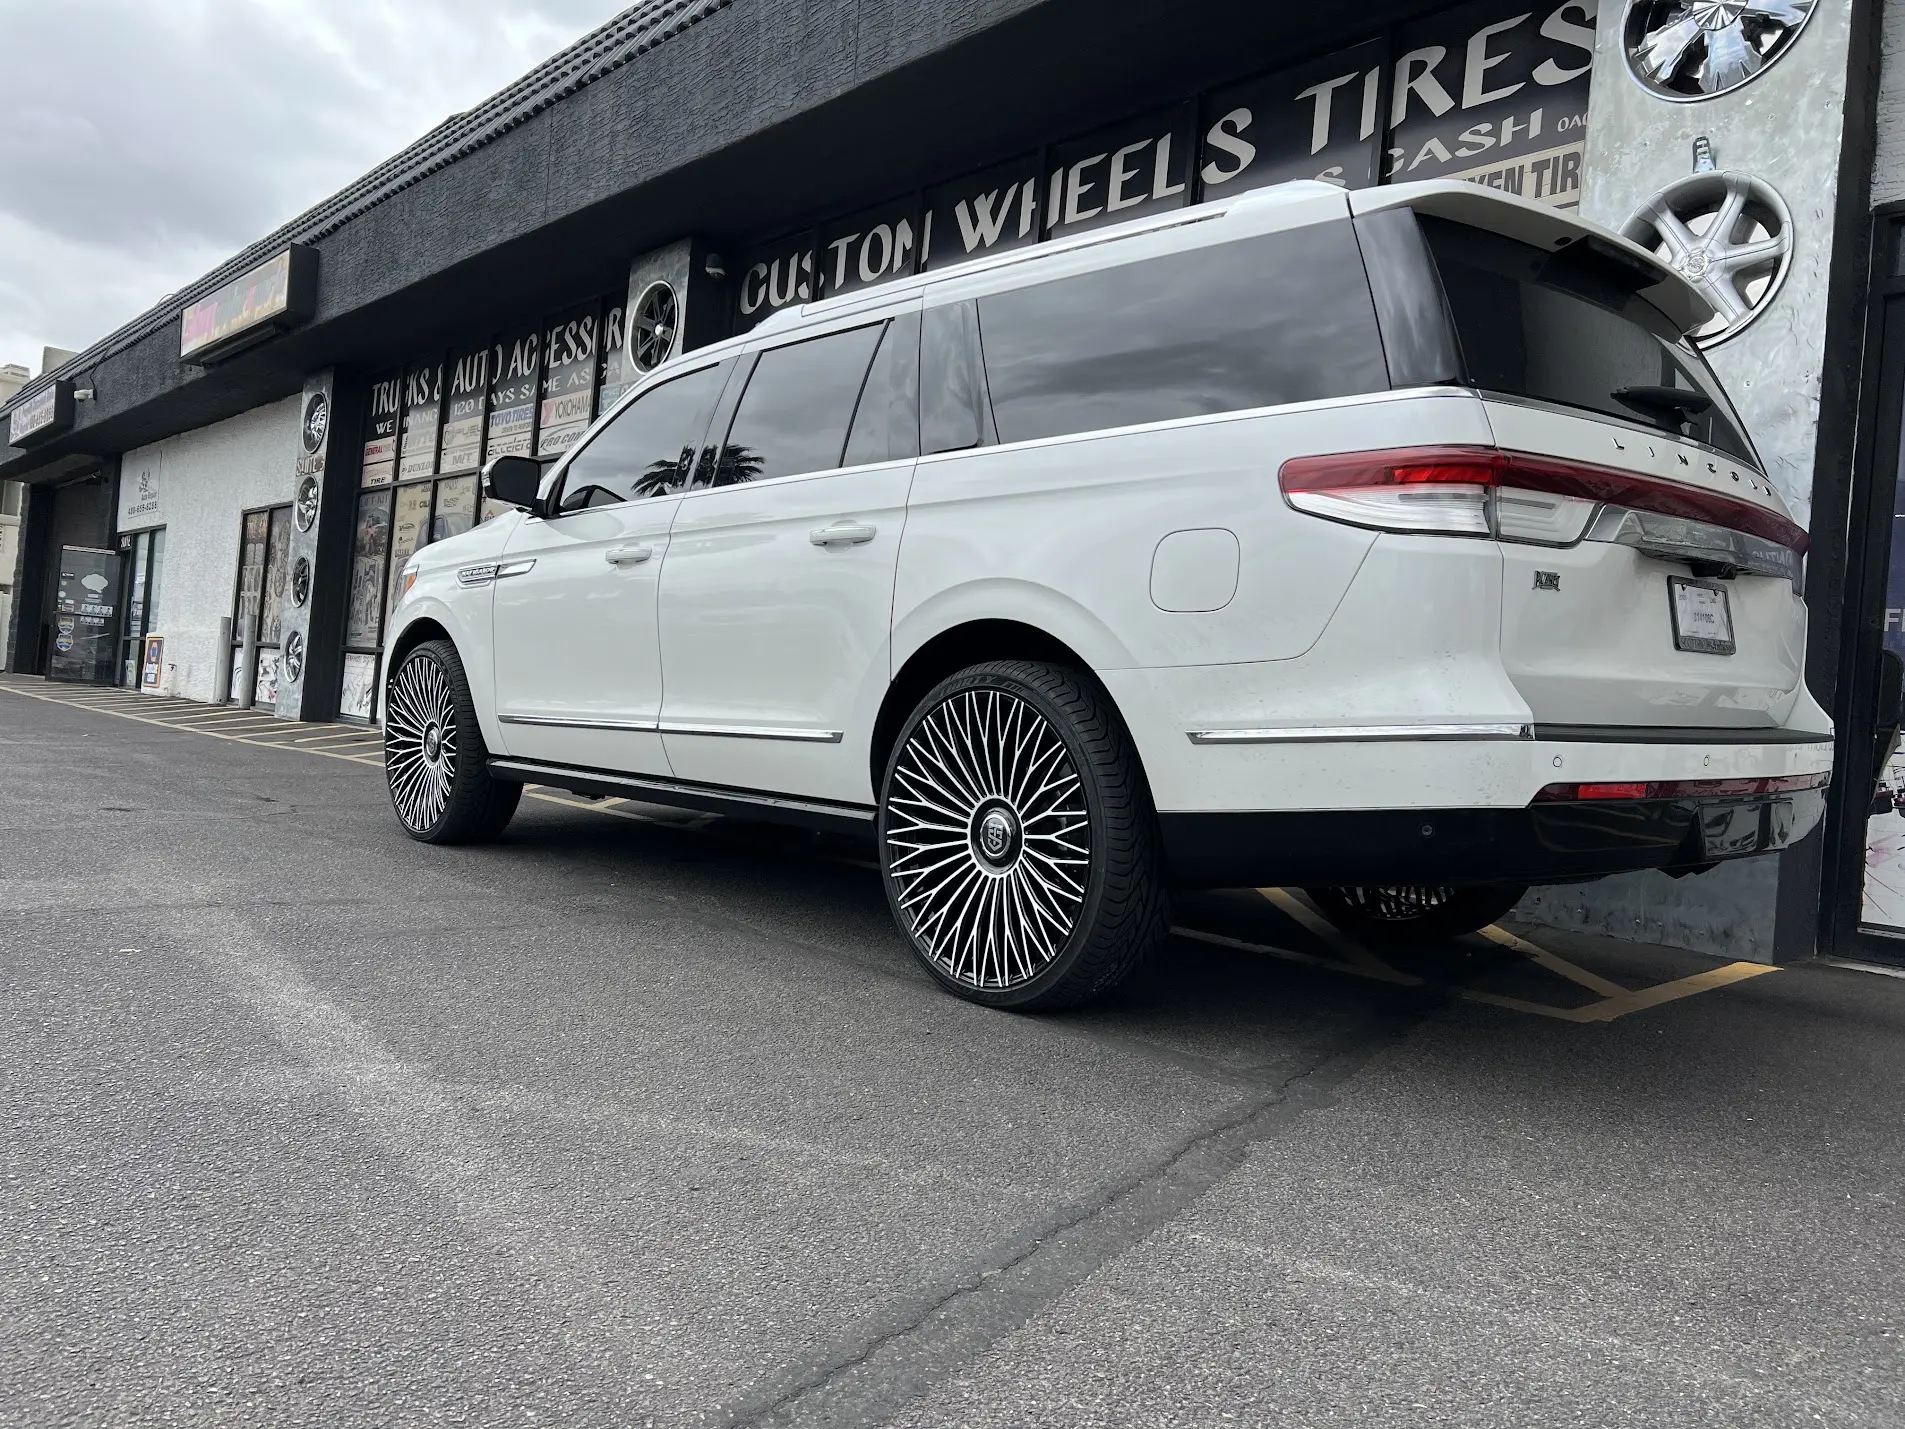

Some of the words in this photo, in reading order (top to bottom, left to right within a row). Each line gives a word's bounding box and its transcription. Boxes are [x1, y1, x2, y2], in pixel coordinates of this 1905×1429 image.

[740, 210, 933, 315] CUSTOM
[955, 107, 1257, 253] WHEELS
[1294, 0, 1598, 155] TIRES
[372, 367, 430, 417] TRUKS
[454, 399, 474, 416] 120
[566, 368, 590, 388] AS
[376, 420, 393, 434] WE
[540, 436, 561, 448] PRO
[370, 476, 386, 485] TIRE
